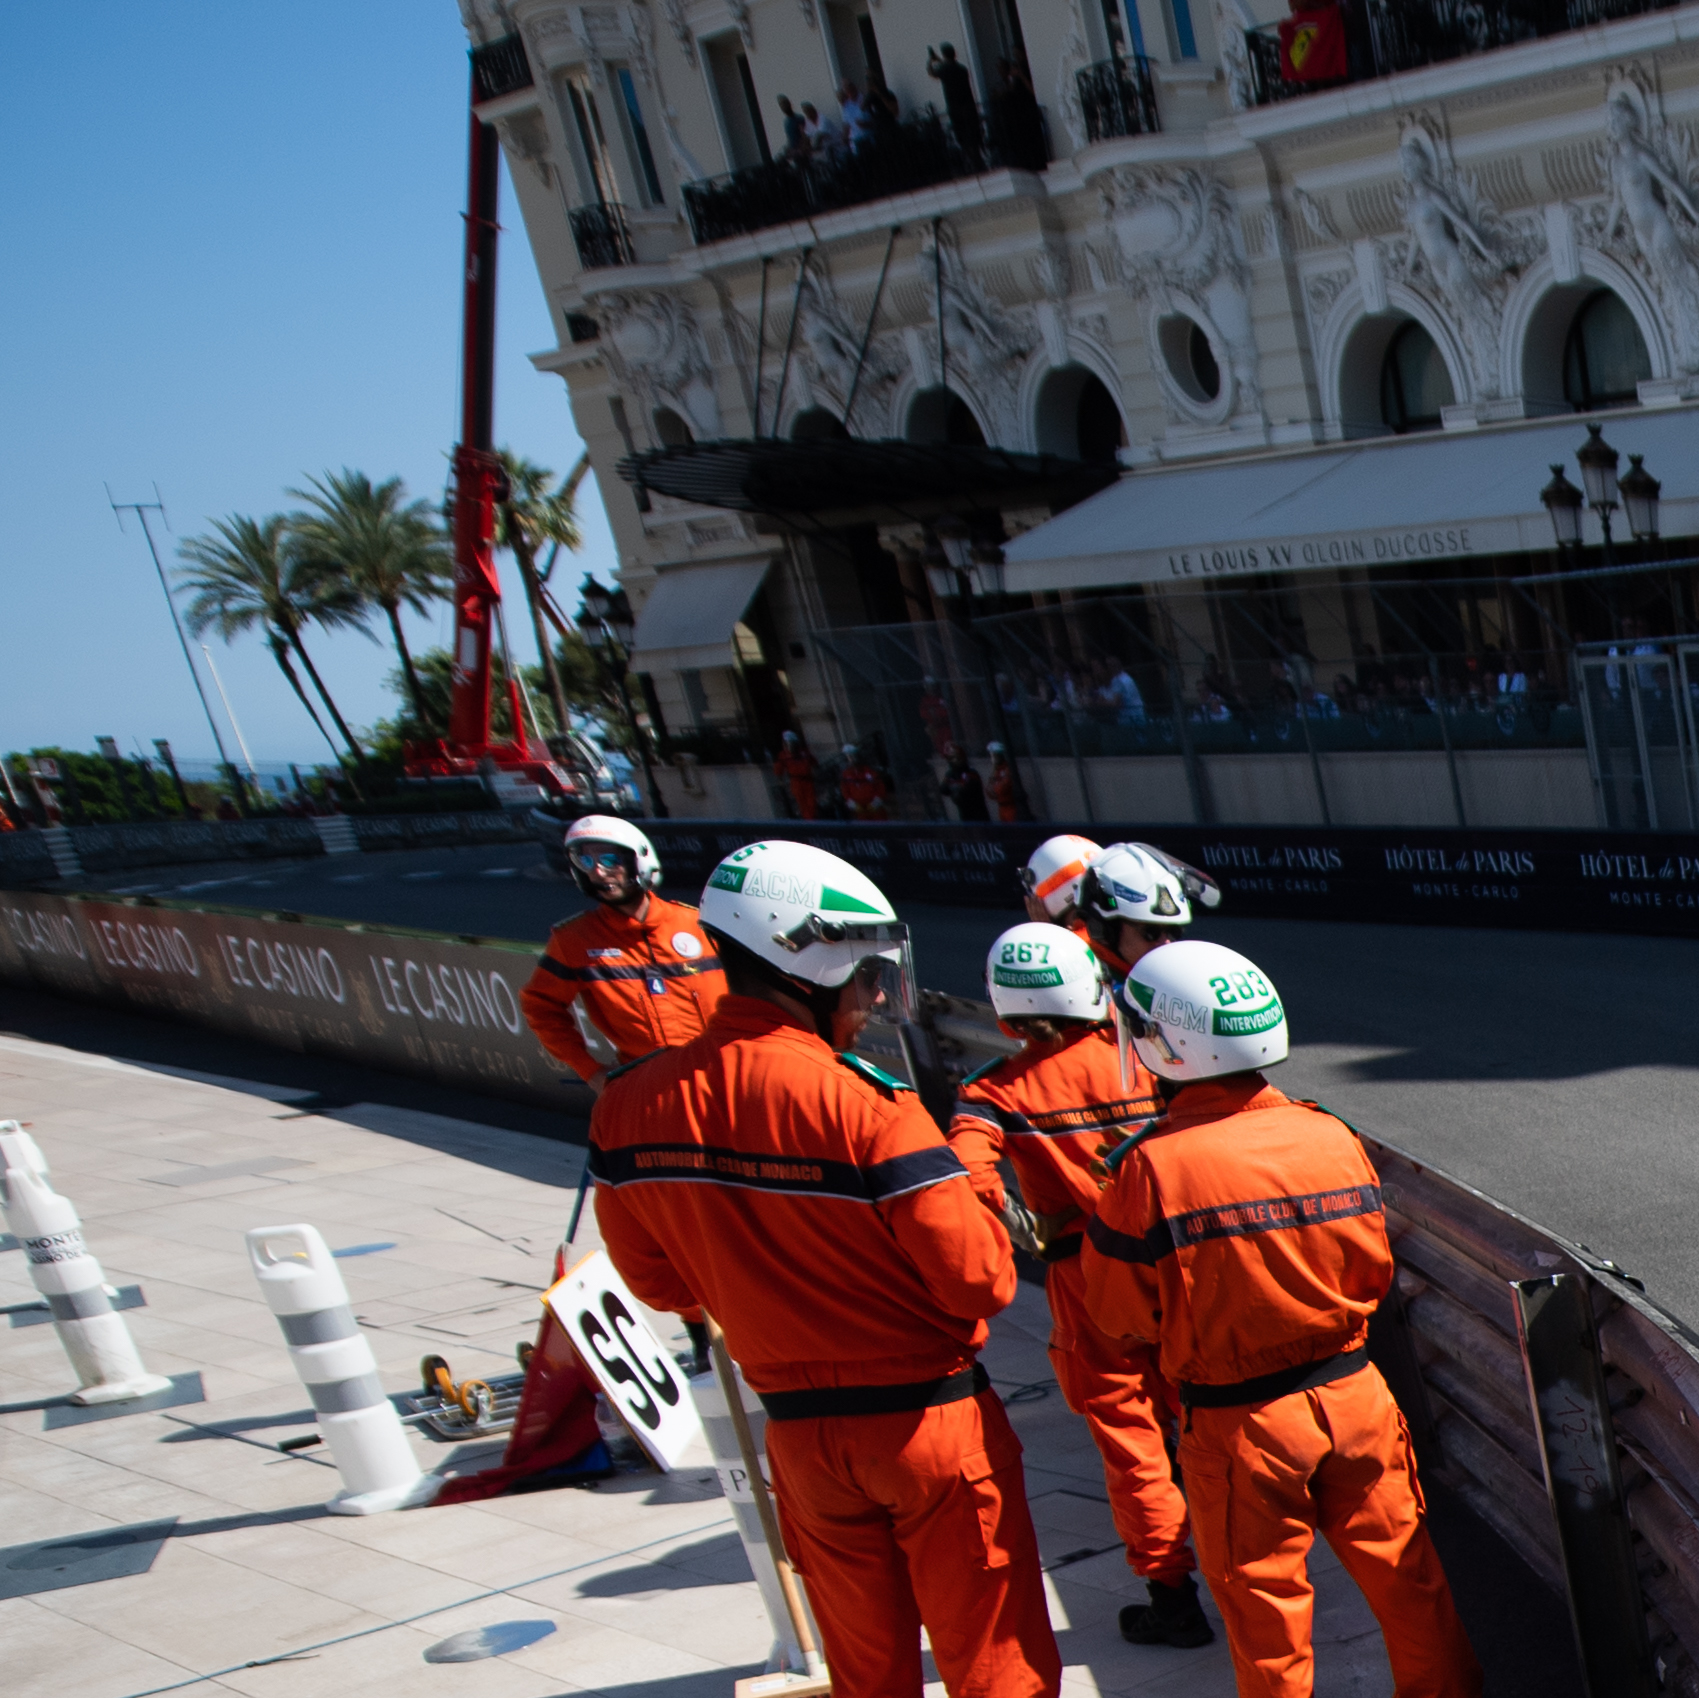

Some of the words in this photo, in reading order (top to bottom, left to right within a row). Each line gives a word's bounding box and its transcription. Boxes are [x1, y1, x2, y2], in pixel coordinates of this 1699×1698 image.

[1169, 553, 1191, 575] LE
[1201, 549, 1260, 571] LOUIS
[1269, 544, 1295, 566] XV
[1302, 540, 1366, 564] ALAIN
[1374, 528, 1474, 559] DUCASSE
[961, 841, 1007, 866] PARIS
[1202, 842, 1268, 870] HÔTEL
[1269, 850, 1283, 868] de
[1284, 848, 1344, 873] PARIS
[1385, 844, 1453, 874] HÔTEL
[1456, 851, 1471, 872] de
[1472, 849, 1536, 878] PARIS
[1579, 850, 1655, 882] HÔTEL
[1659, 856, 1676, 881] de
[744, 868, 816, 908] ACM
[1001, 942, 1050, 965] 267
[996, 971, 1058, 985] INTERVENTION
[1208, 970, 1269, 1007] 283
[1153, 993, 1208, 1034] ACM
[1219, 1003, 1281, 1032] INTERVENTION
[760, 1162, 824, 1182] MONACO
[1186, 1204, 1268, 1236] AUTOMOBILE
[1270, 1200, 1298, 1221] CLUB
[1303, 1199, 1318, 1215] DE
[1321, 1191, 1363, 1212] MONACO
[26, 1230, 81, 1249] MONTE
[576, 1289, 682, 1432] SC
